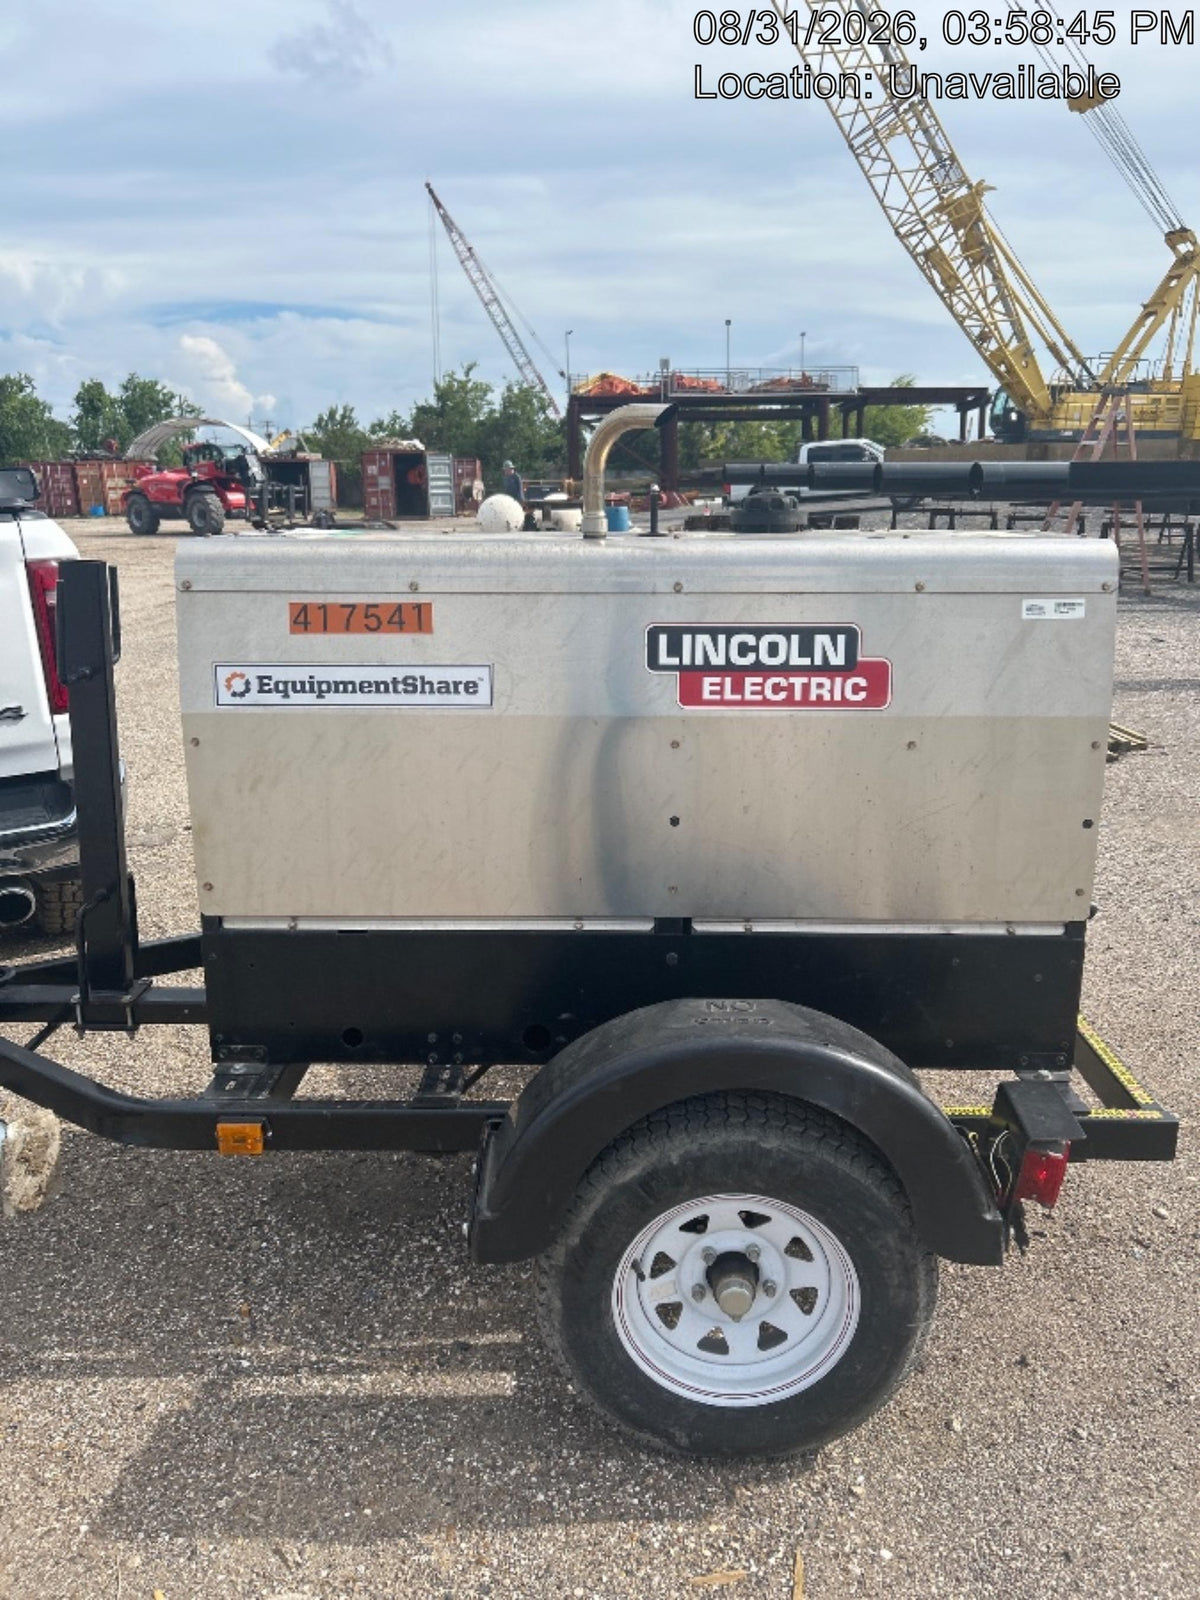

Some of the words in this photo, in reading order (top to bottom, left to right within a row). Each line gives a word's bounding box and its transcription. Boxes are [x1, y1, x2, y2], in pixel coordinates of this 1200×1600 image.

[292, 603, 424, 632] 417541
[658, 633, 846, 666] LINCOLN
[702, 676, 868, 702] ELECTRIC
